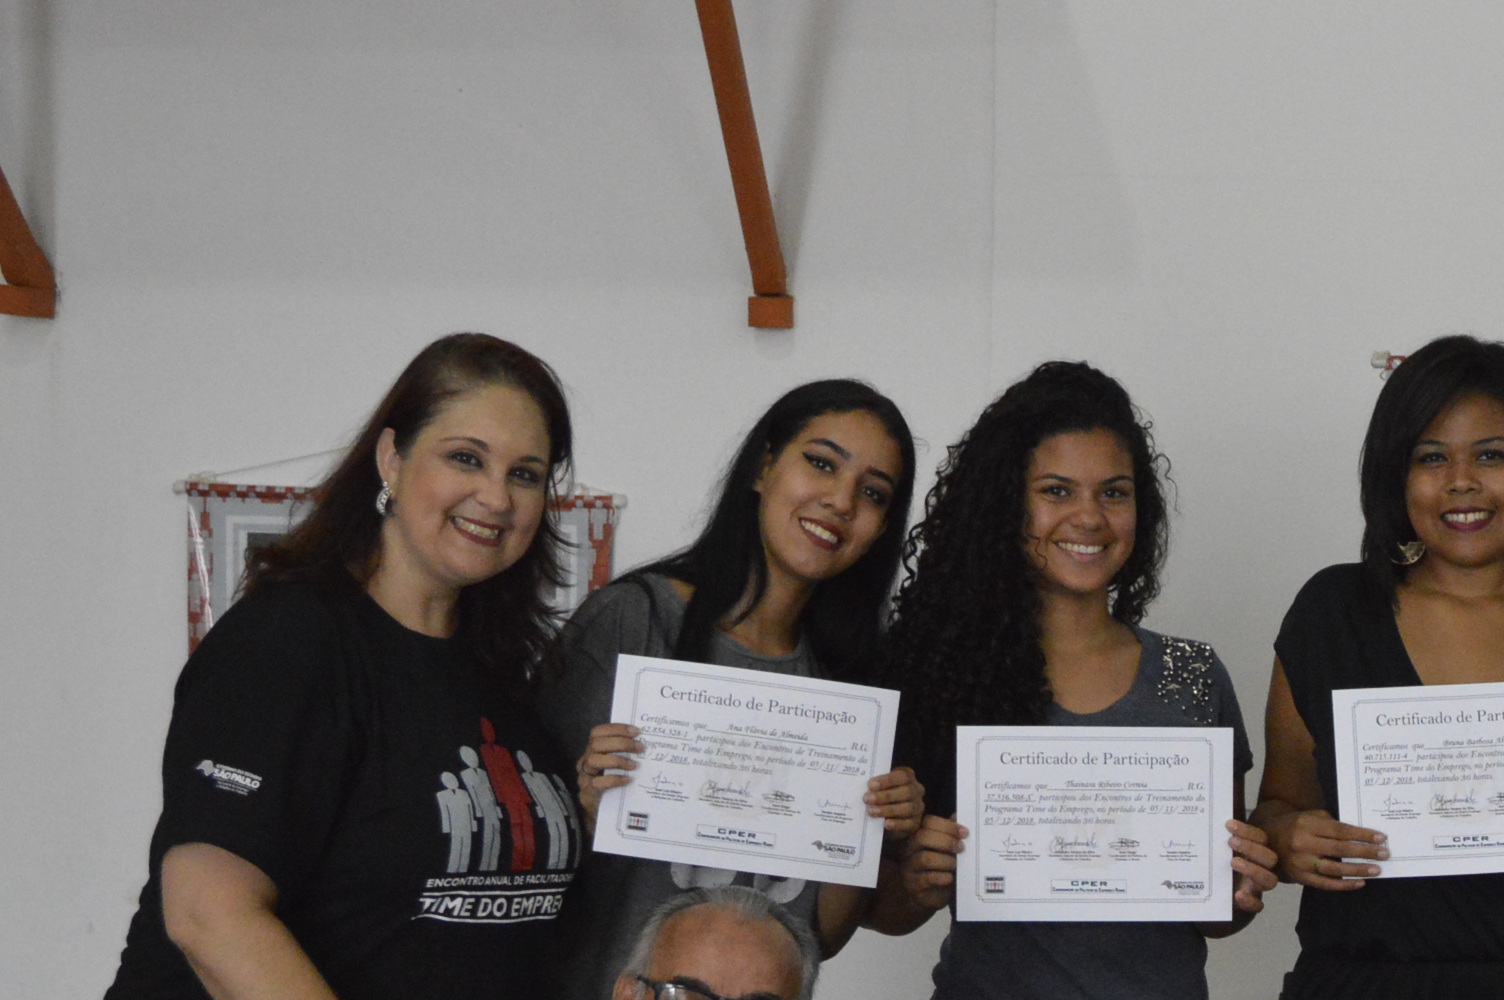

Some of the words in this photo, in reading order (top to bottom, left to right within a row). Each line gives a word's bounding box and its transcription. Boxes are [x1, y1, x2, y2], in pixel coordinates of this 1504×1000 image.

[660, 683, 742, 708] Certificado
[745, 695, 764, 711] de
[767, 698, 857, 728] Participação
[1375, 710, 1452, 727] Certificado
[1455, 709, 1472, 723] de
[639, 712, 690, 729] Certificamos
[692, 722, 707, 732] que
[850, 741, 869, 752] R.G.
[1362, 742, 1408, 754] Certificamos
[1411, 743, 1424, 751] que
[1000, 751, 1077, 765] Certificado
[1081, 751, 1098, 765] de
[1103, 751, 1189, 769] Participação
[230, 772, 260, 789] PAULO
[984, 781, 1031, 791] Certificamos
[1034, 783, 1047, 791] que
[1187, 782, 1204, 790] R.G.
[1038, 793, 1076, 803] participou
[1079, 793, 1091, 801] dos
[1093, 793, 1131, 801] Encontros
[1134, 793, 1142, 801] de
[1146, 793, 1192, 801] Treinamento
[1195, 793, 1205, 801] do
[717, 827, 757, 839] CPER
[1452, 834, 1489, 842] CPER
[426, 875, 485, 888] ENCONTRO
[485, 875, 512, 886] ANUAL
[514, 875, 525, 885] DE
[526, 873, 575, 884] FACILITADO
[419, 897, 475, 917] TIME
[476, 897, 507, 918] DO
